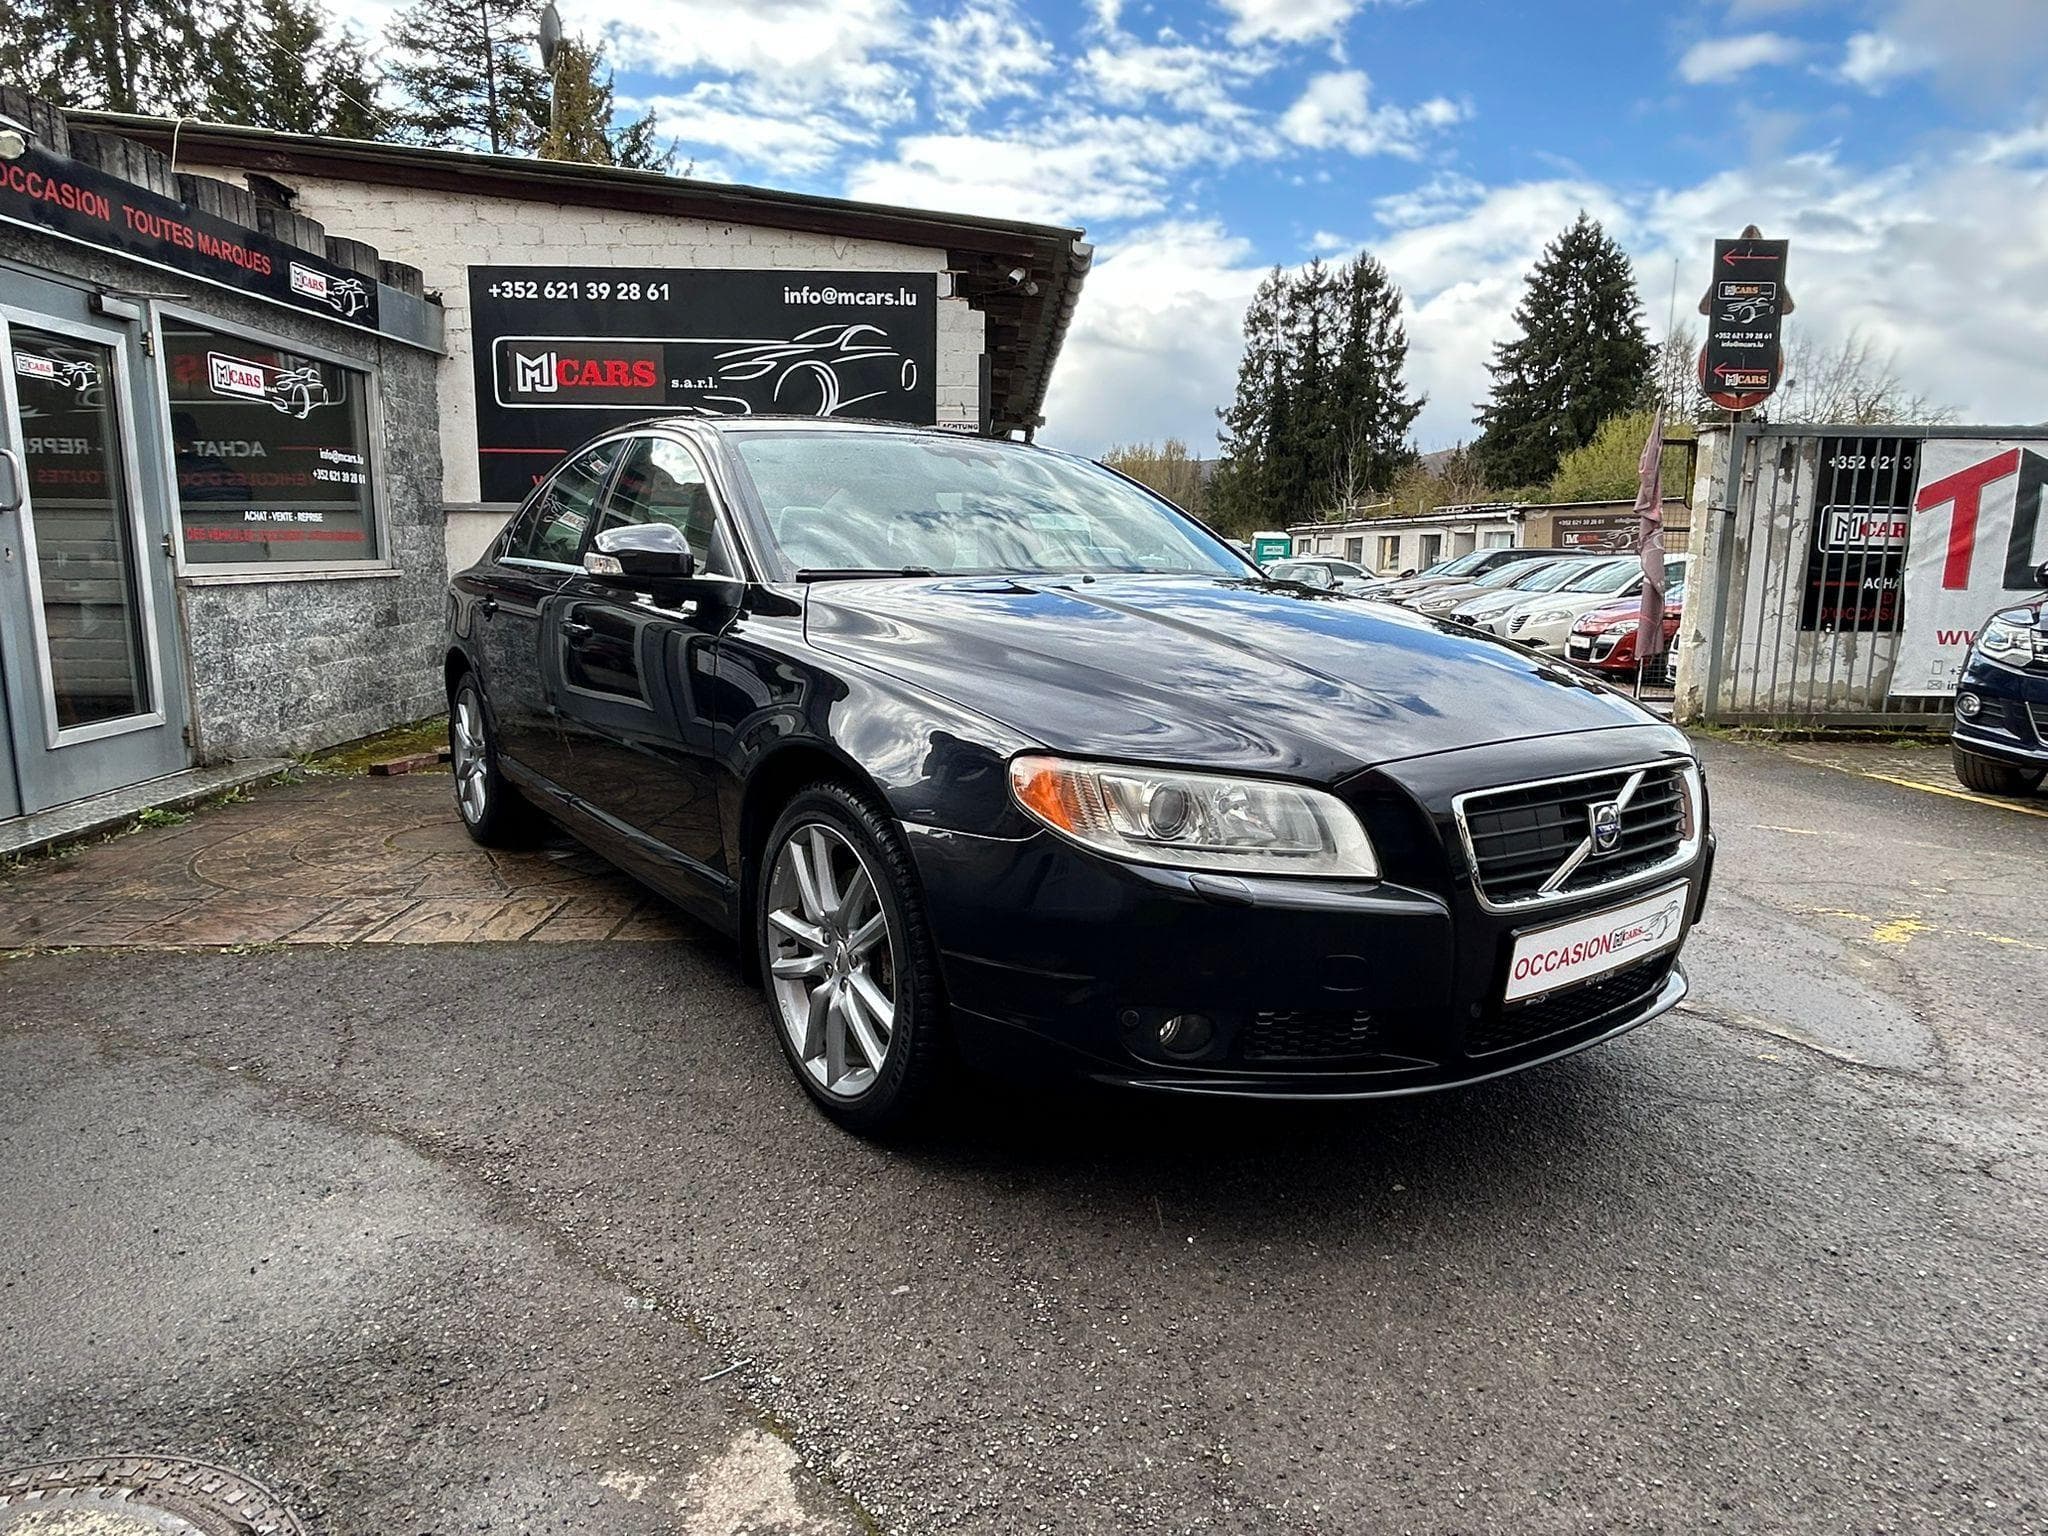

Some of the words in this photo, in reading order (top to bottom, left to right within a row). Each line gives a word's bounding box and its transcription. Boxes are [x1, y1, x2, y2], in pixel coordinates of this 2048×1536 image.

[122, 204, 194, 249] TOUTES
[198, 232, 272, 275] MARQUES
[488, 281, 538, 299] +352
[544, 282, 579, 299] 621
[586, 283, 611, 300] 39
[616, 283, 641, 300] 28
[647, 283, 670, 301] 61
[784, 287, 917, 306] info@mcars.lu
[1764, 332, 1773, 340] 61
[671, 376, 718, 389] s.a.r.l.
[1828, 455, 1866, 470] +352
[312, 468, 329, 481] +352
[329, 470, 341, 482] 621
[358, 473, 366, 485] 61
[244, 511, 267, 521] ACHAT
[272, 512, 294, 522] VENTE
[297, 512, 324, 522] REPRISE
[1514, 932, 1613, 980] OCCASION
